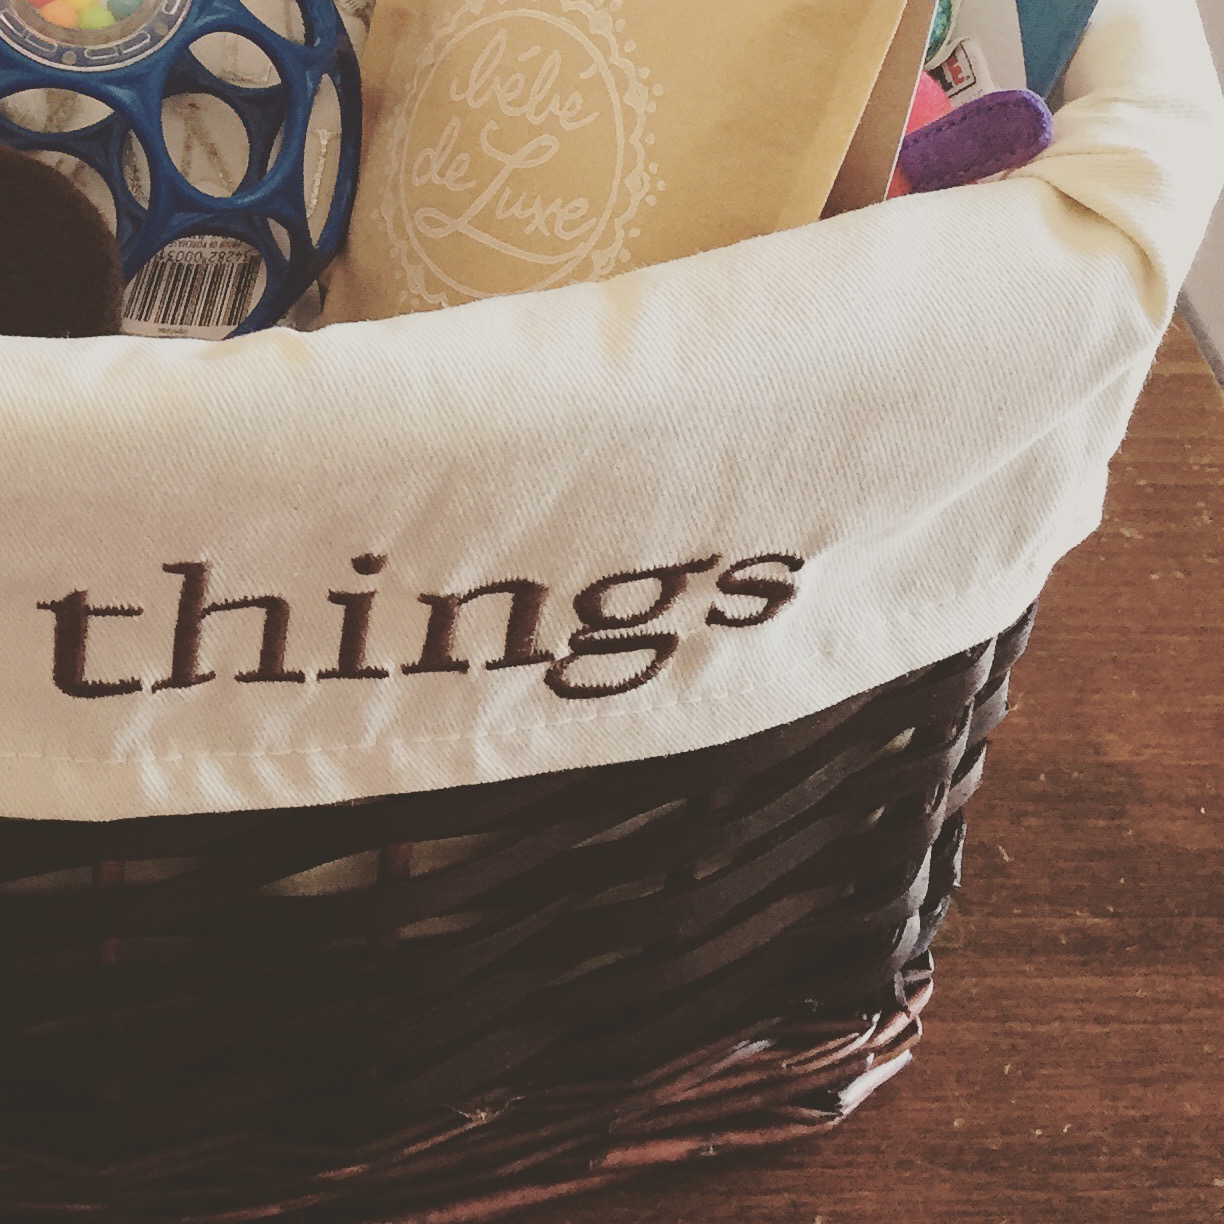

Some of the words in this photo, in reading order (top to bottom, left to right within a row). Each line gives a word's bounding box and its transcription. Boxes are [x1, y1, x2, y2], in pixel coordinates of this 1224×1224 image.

[411, 115, 476, 192] de
[414, 119, 598, 265] Luxe
[36, 552, 806, 700] things
